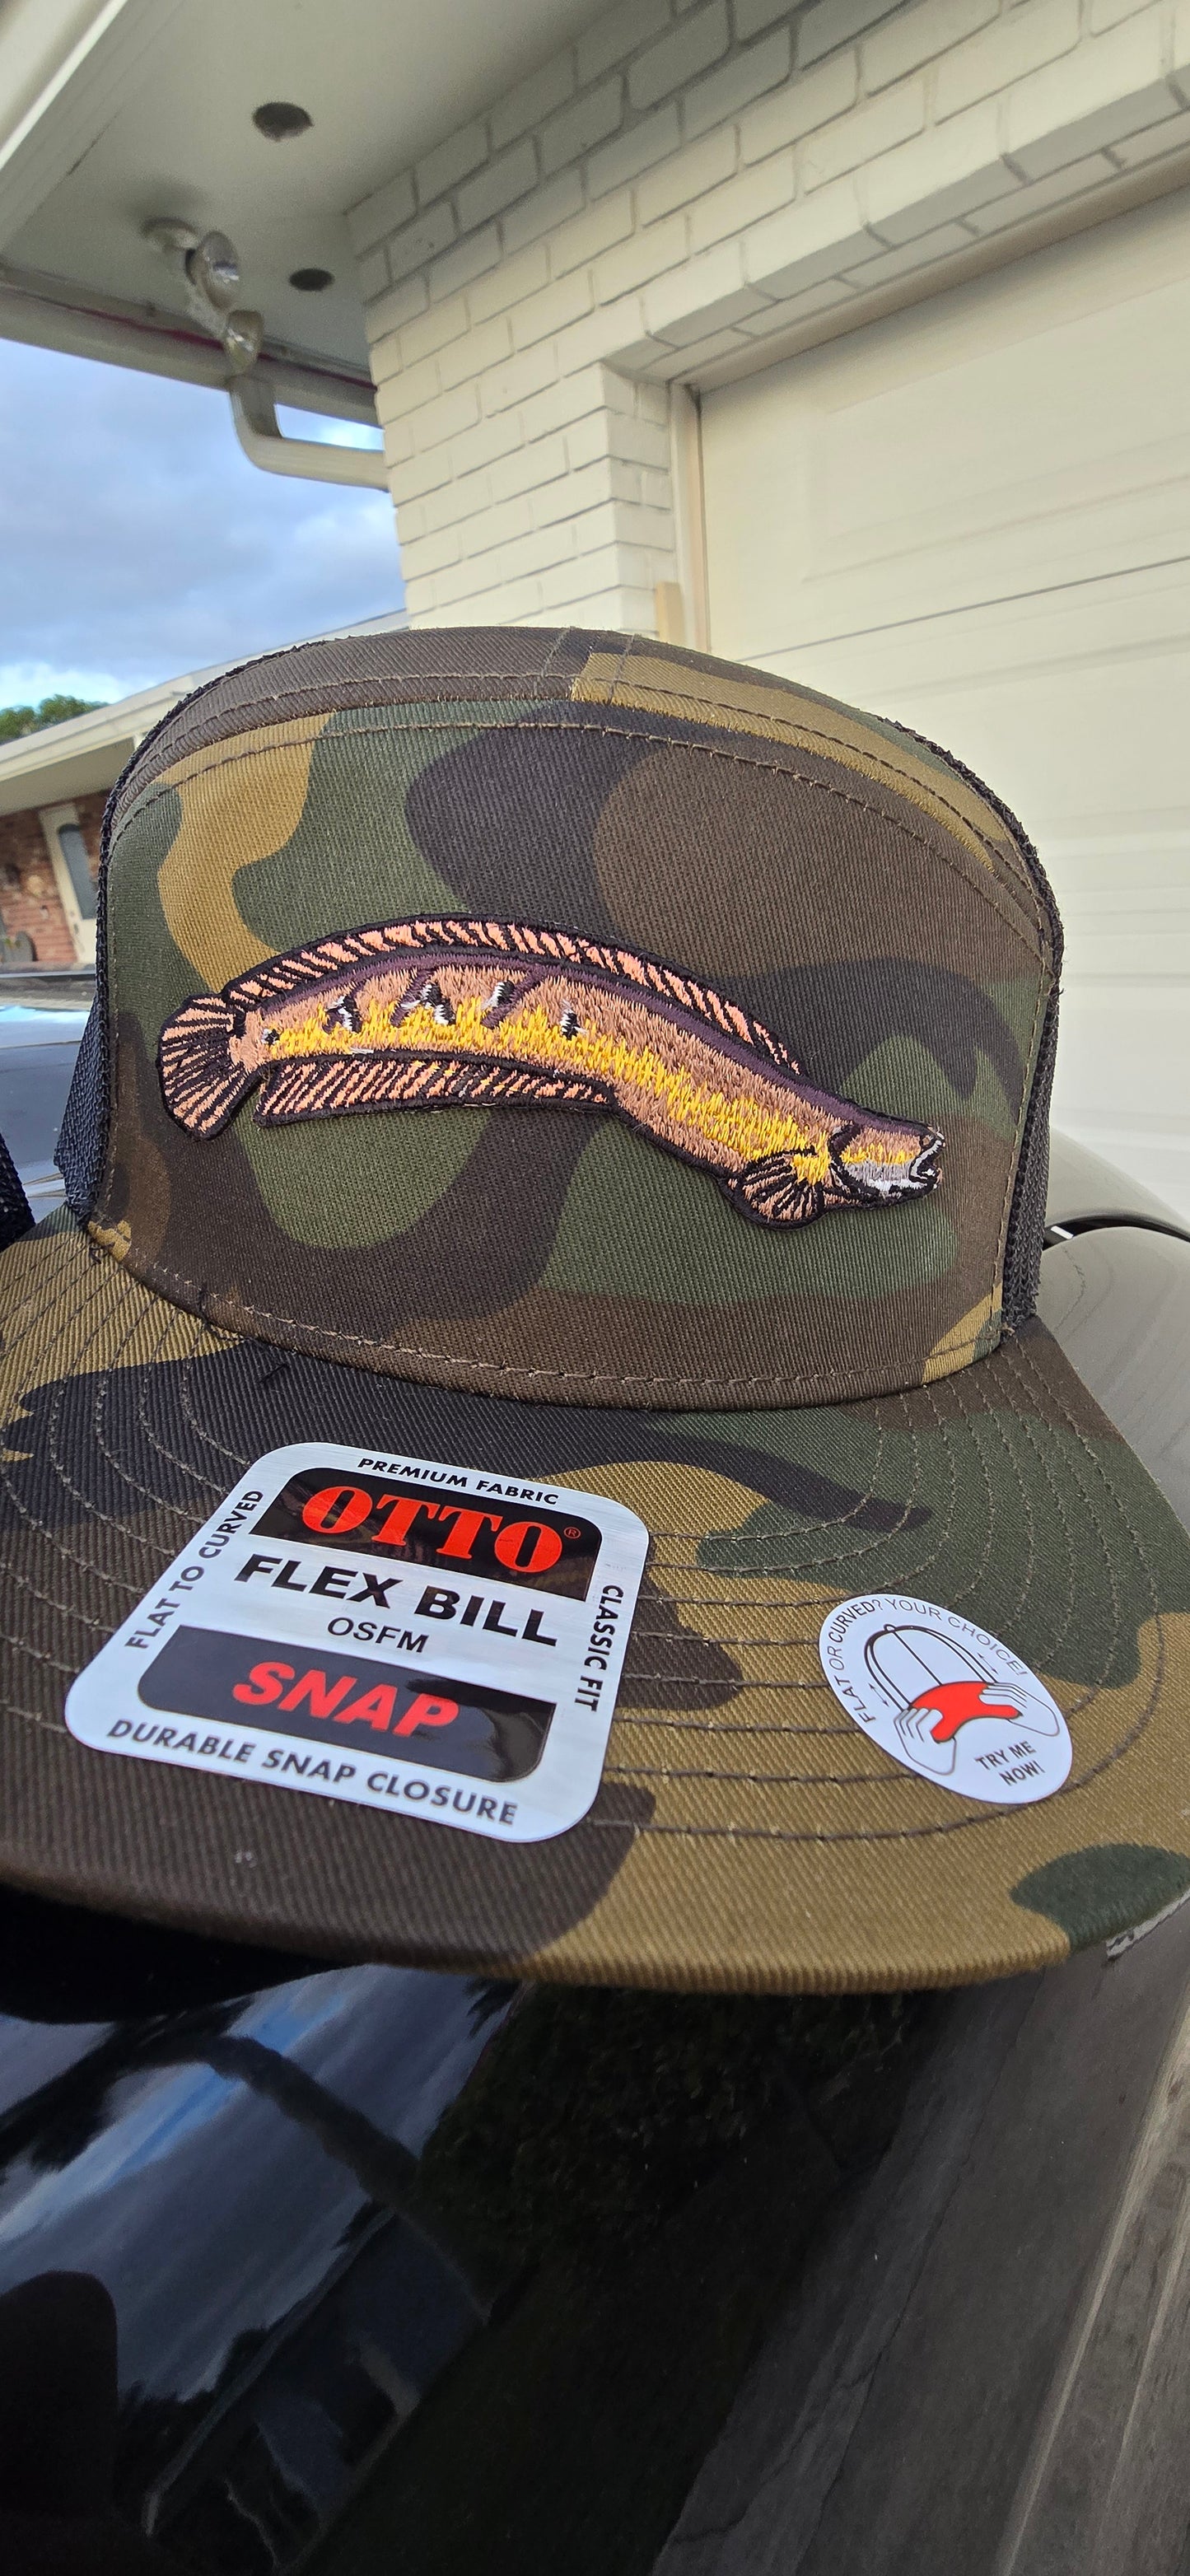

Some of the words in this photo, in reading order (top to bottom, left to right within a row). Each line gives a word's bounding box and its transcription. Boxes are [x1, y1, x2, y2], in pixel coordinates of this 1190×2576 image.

[357, 1457, 469, 1490] PREMIUM
[476, 1479, 560, 1505] FABRIC
[127, 1598, 180, 1650] FLAT
[175, 1566, 204, 1592] TO
[199, 1490, 264, 1559] CURVED
[235, 1554, 403, 1608] FLEX
[414, 1586, 558, 1646] BILL
[828, 1598, 883, 1643] CURVED?
[885, 1598, 942, 1621] YOUR
[327, 1617, 429, 1654] OSFM
[584, 1584, 623, 1673] CLASSIC
[948, 1616, 1028, 1676] CHOICE!
[827, 1645, 844, 1671] OR
[232, 1662, 460, 1738] SNAP
[575, 1678, 604, 1711] FIT
[834, 1675, 876, 1723] FLAT
[107, 1720, 253, 1764] DURABLE
[261, 1751, 357, 1784] SNAP
[366, 1773, 518, 1825] CLOSURE
[973, 1751, 1008, 1771] TRY
[1011, 1741, 1036, 1760] ME
[998, 1761, 1045, 1786] NOW!
